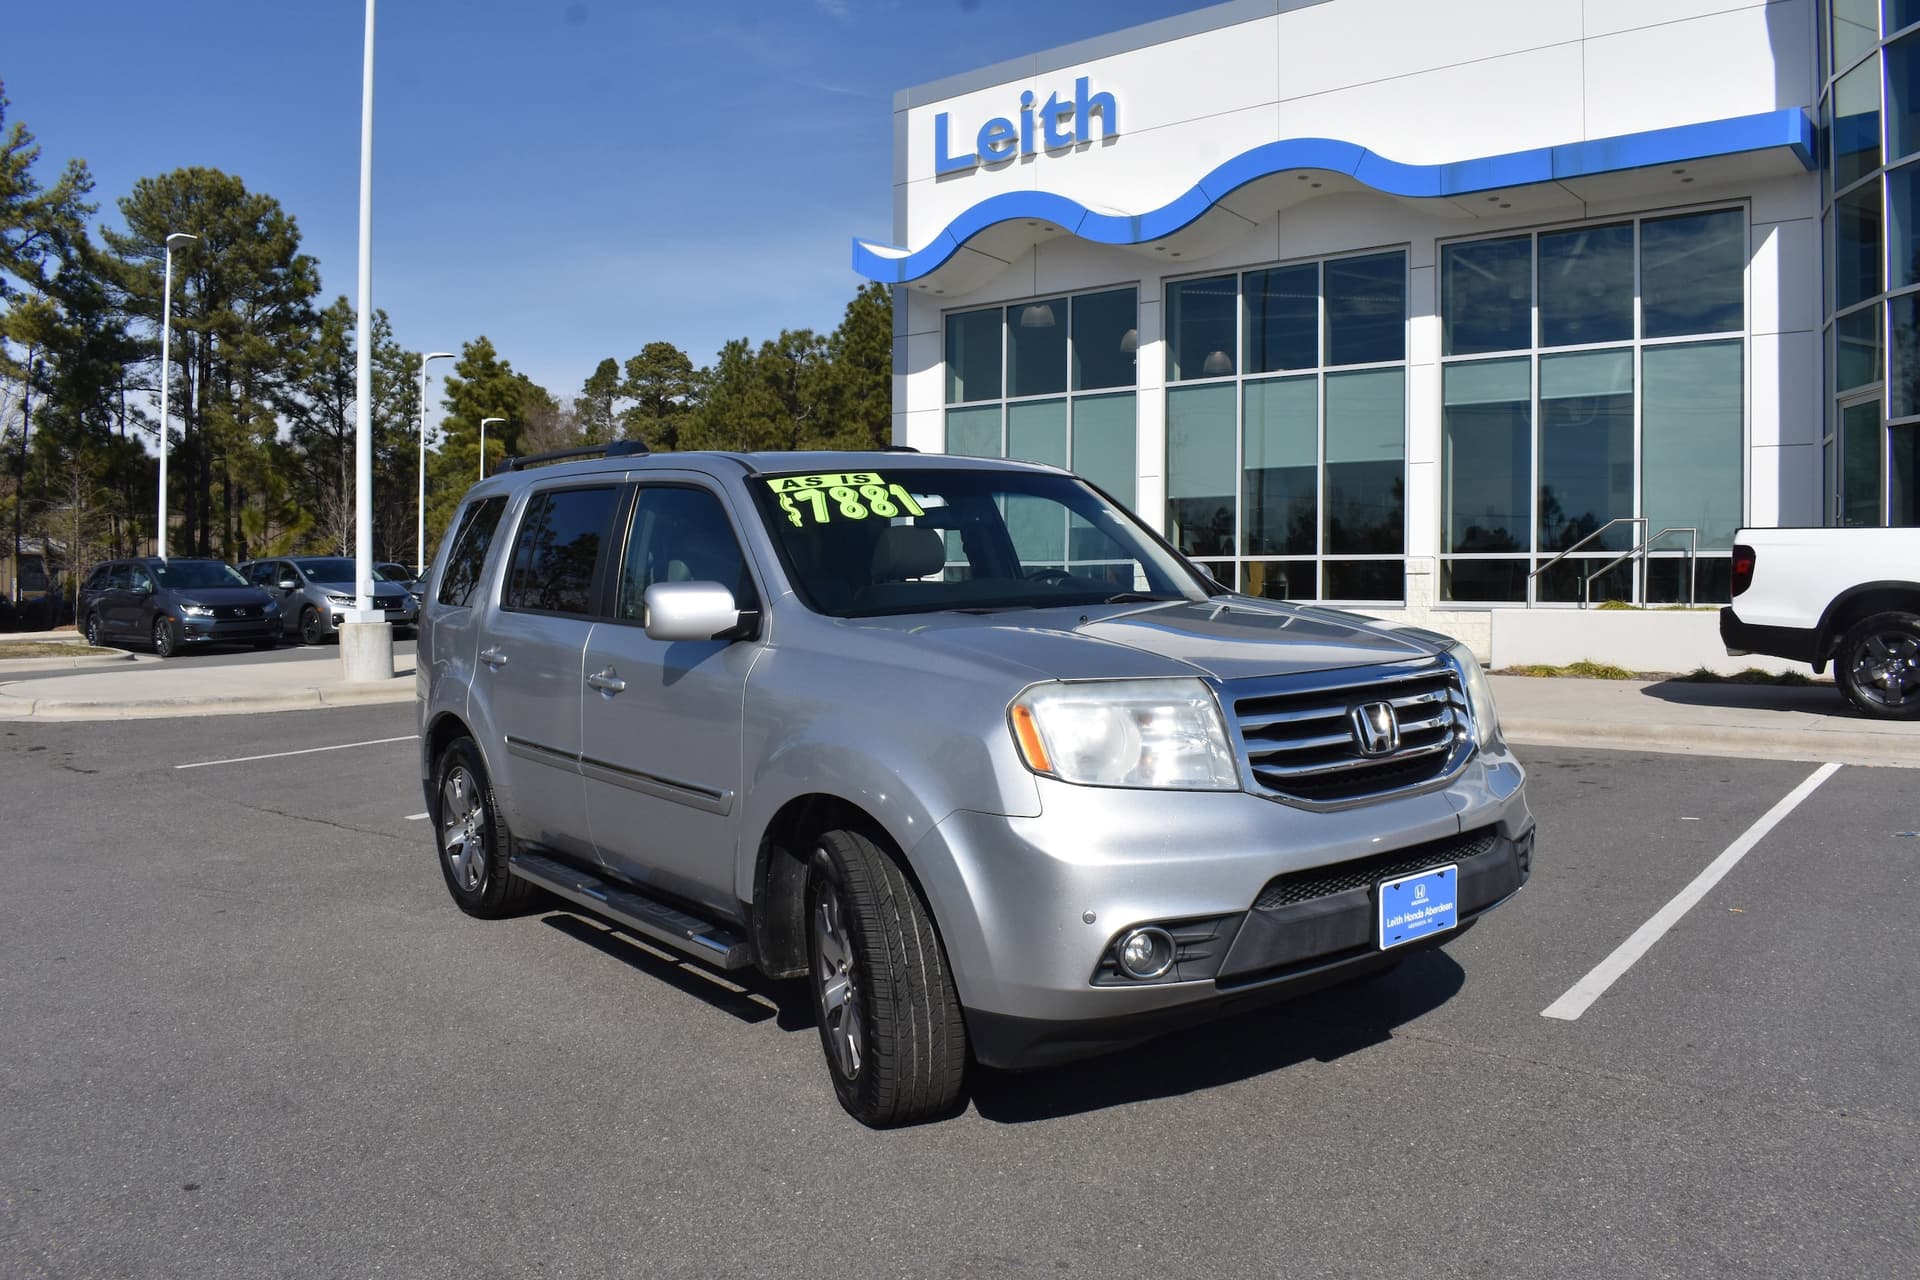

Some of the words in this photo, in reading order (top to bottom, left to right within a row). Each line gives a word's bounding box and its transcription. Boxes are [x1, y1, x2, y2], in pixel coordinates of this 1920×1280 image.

[934, 76, 1117, 176] Leith
[781, 476, 824, 490] AS
[778, 483, 926, 528] $7881
[1386, 915, 1403, 928] Leith
[1403, 909, 1424, 923] Honda
[1424, 902, 1453, 917] Aberdeen
